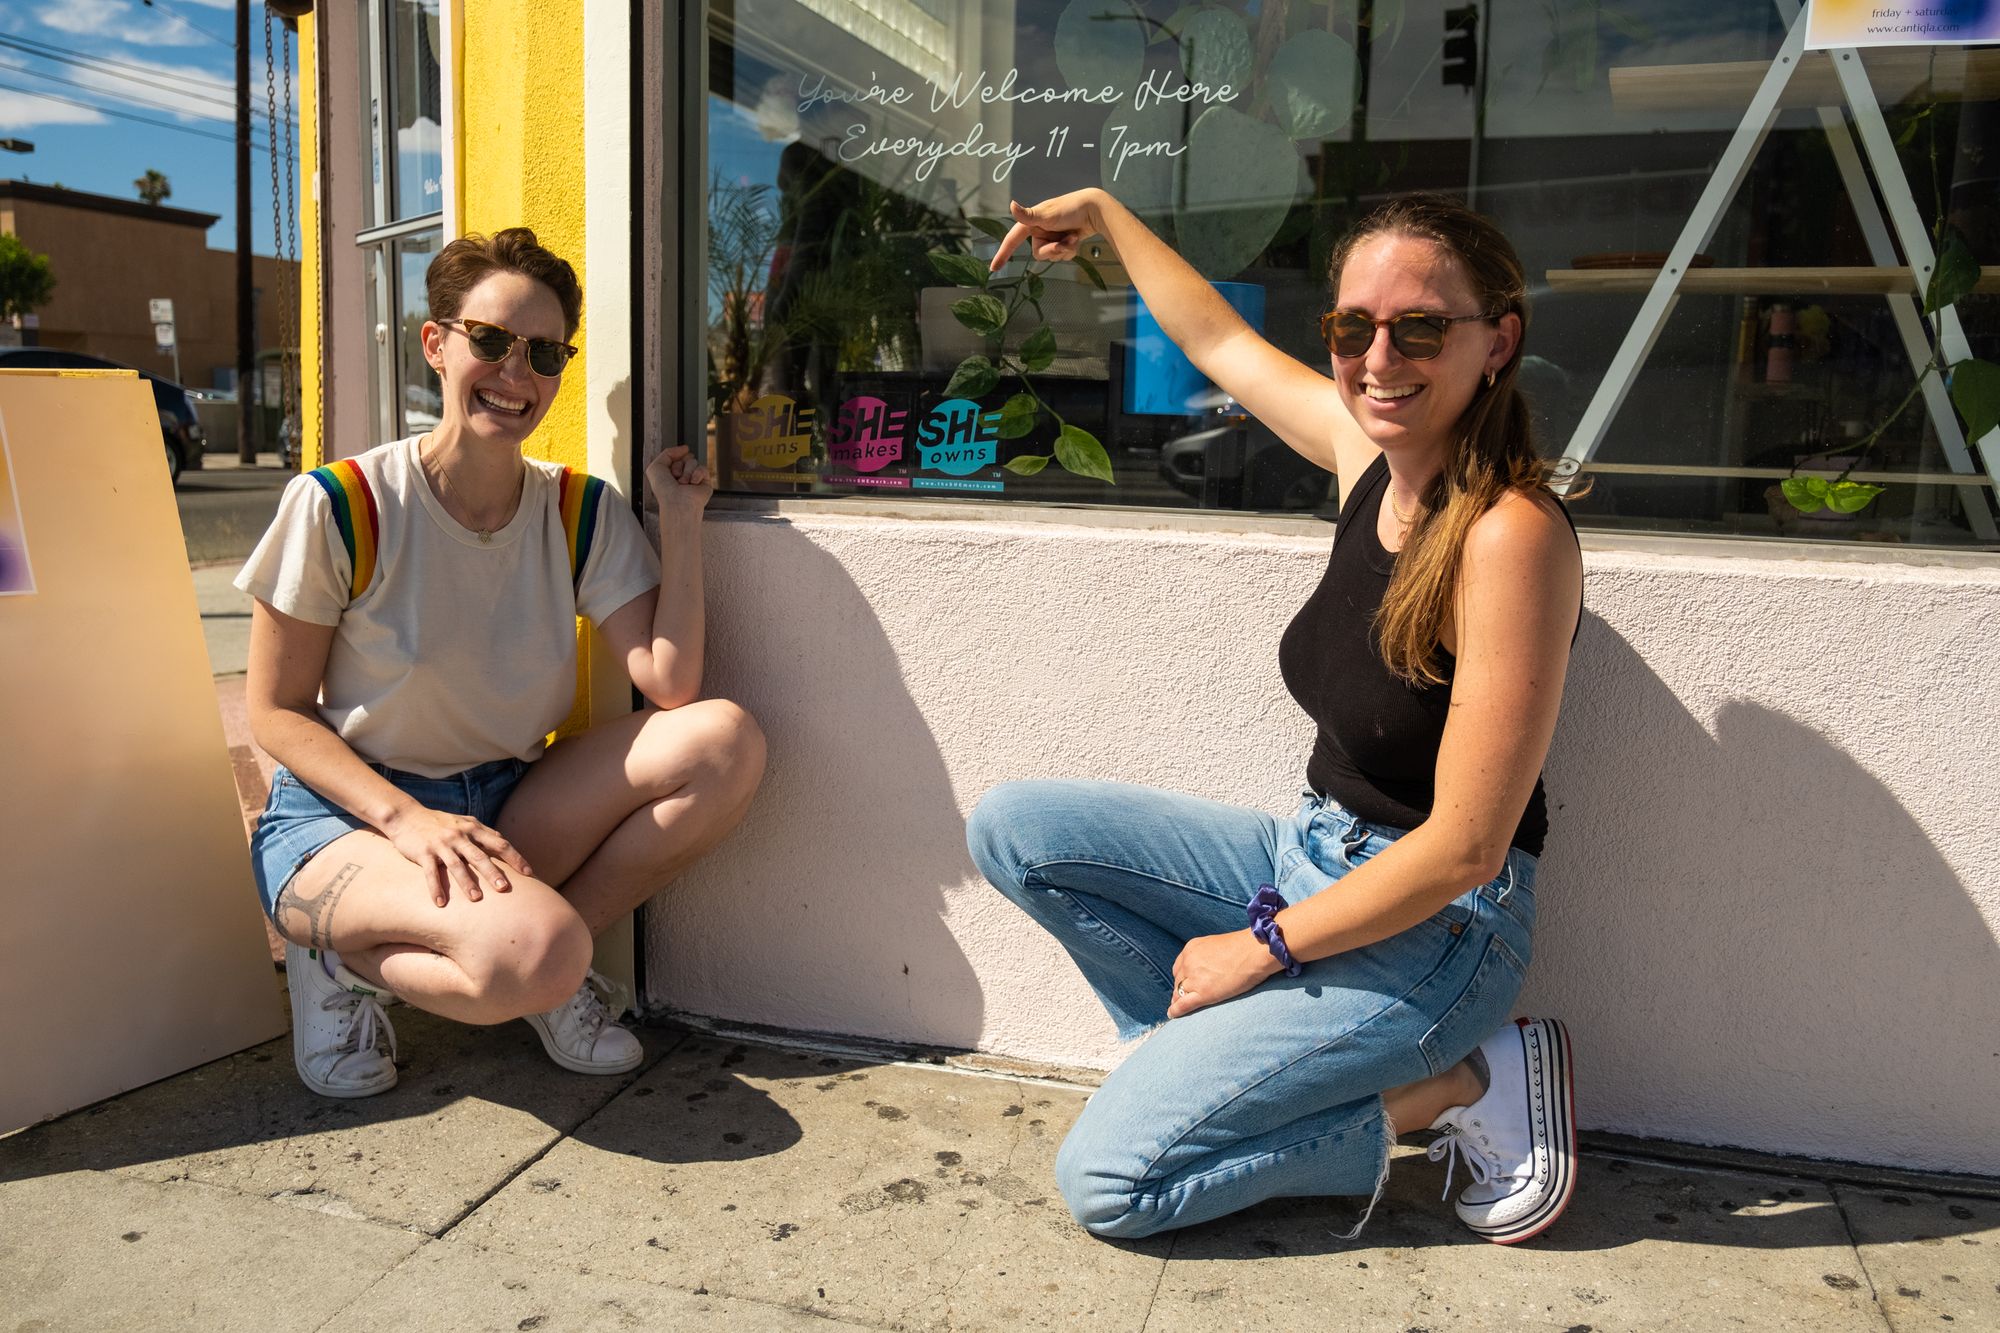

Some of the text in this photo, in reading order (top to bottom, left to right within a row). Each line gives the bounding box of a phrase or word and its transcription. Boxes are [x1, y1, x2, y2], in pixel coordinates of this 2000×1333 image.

[1872, 8, 1901, 19] friday
[797, 68, 1239, 113] You're Welcome Here
[839, 123, 1035, 183] Everyday
[1046, 126, 1069, 158] 11
[1109, 126, 1188, 181] 7pm
[737, 403, 816, 441] SHE
[829, 404, 908, 445] SHE
[919, 407, 1003, 448] SHE
[754, 440, 798, 455] runs
[832, 439, 898, 460] makes
[930, 447, 987, 464] owns
